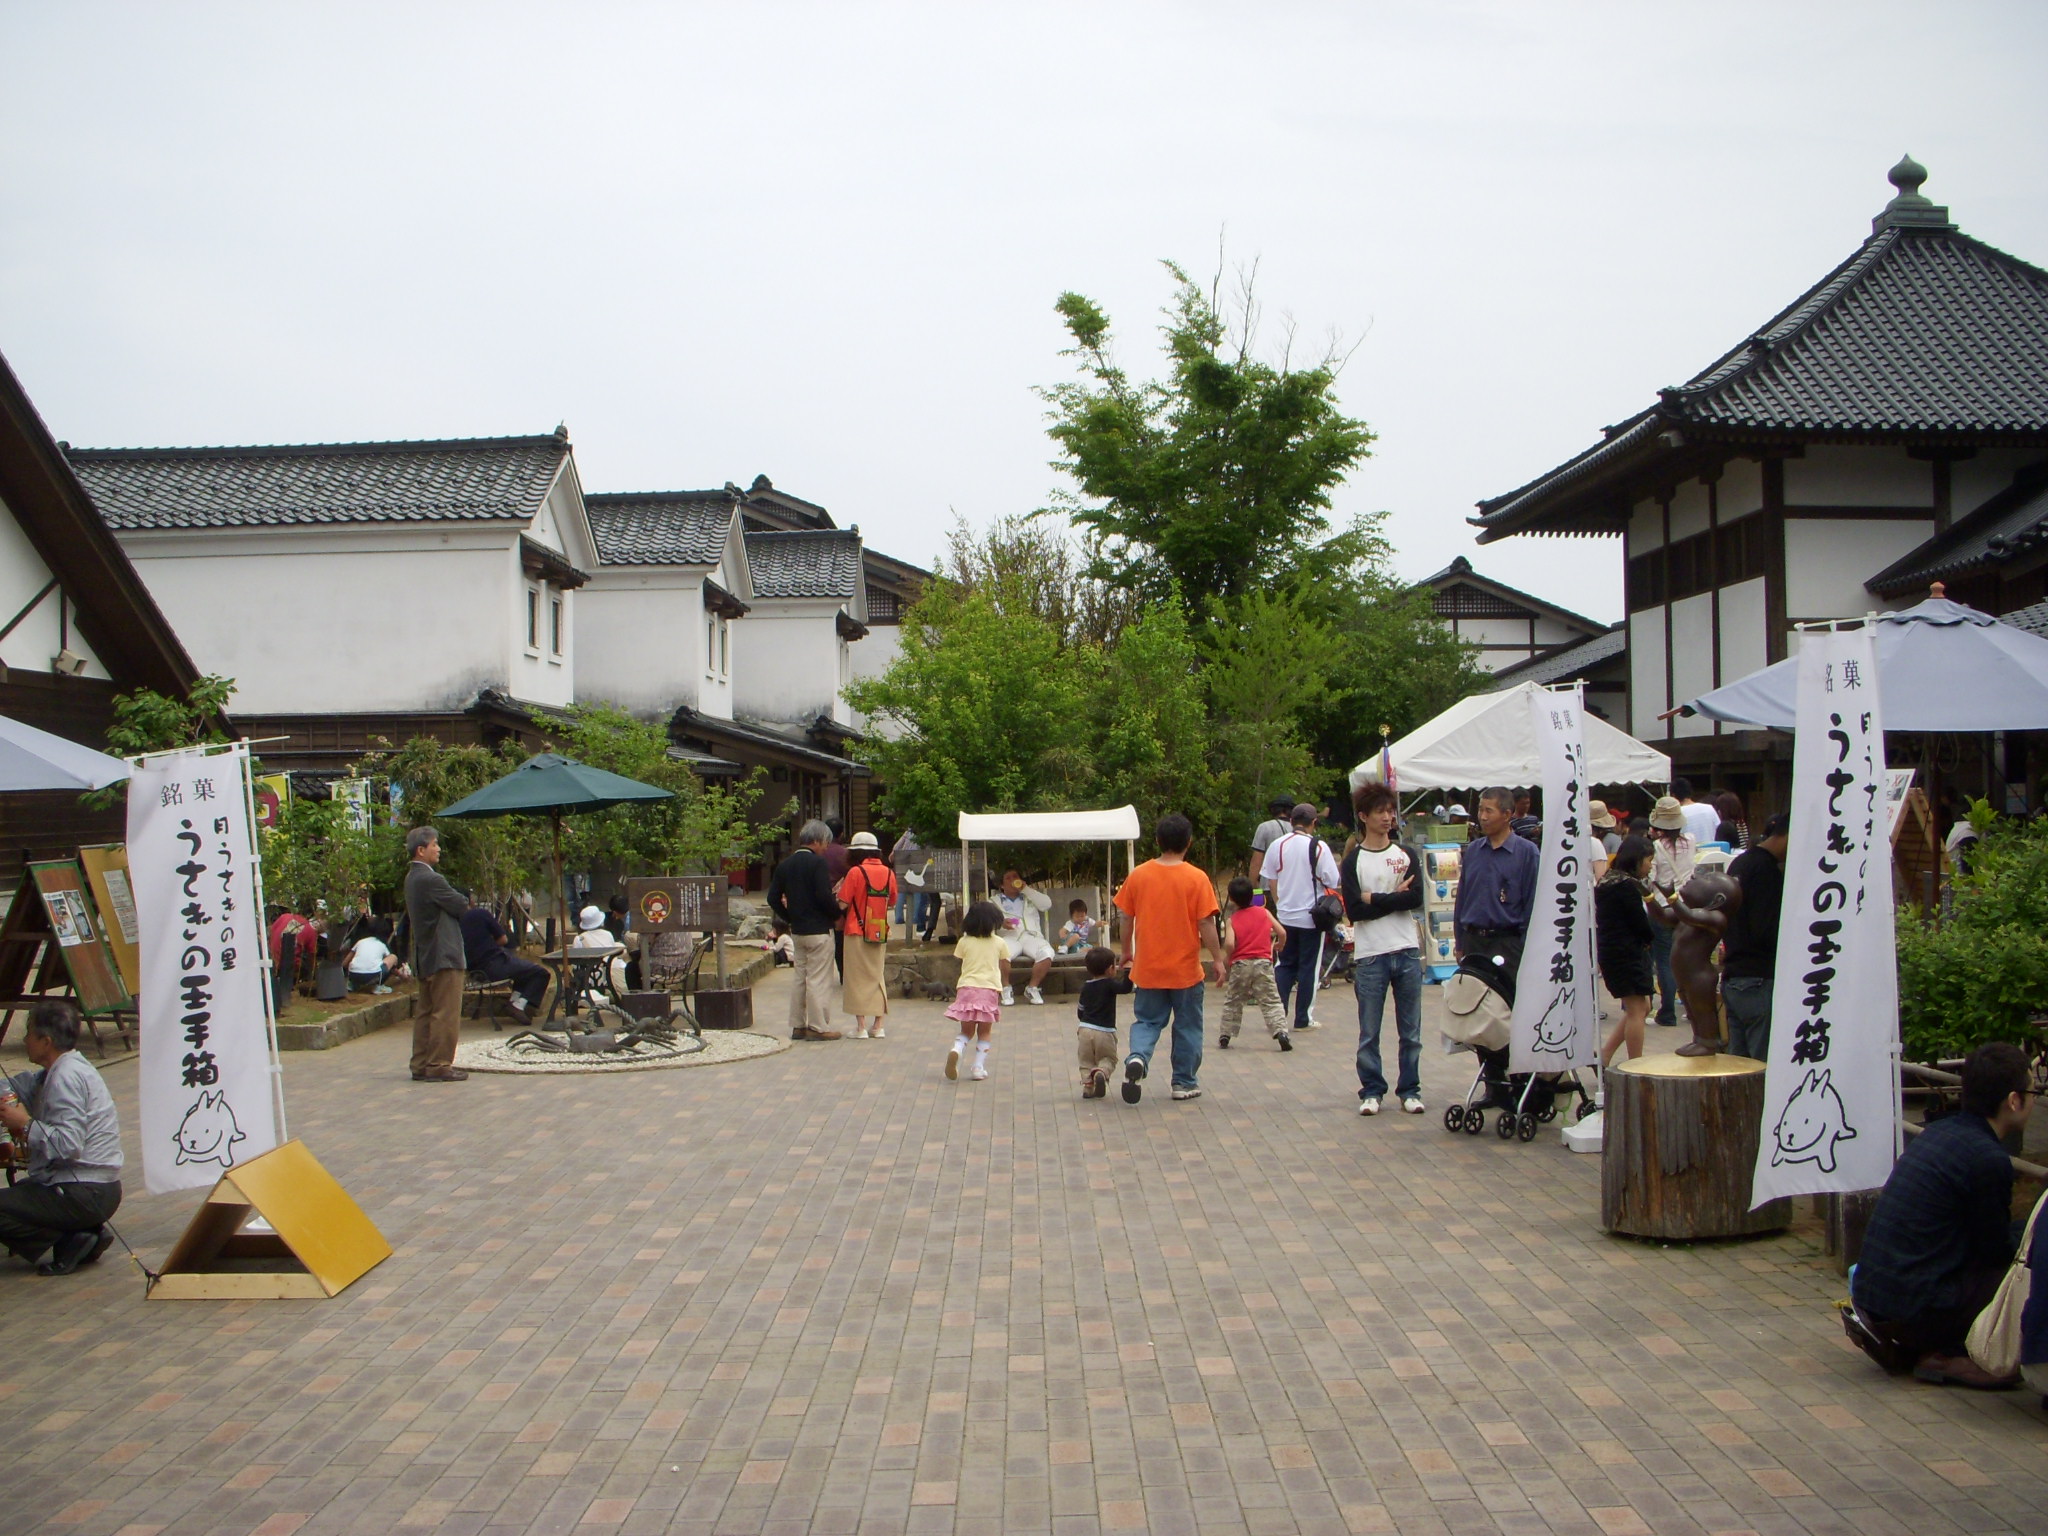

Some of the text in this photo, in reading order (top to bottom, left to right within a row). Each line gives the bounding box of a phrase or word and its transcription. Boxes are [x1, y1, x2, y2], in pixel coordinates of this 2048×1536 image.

[160, 778, 216, 807] 銘菓
[1550, 709, 1574, 731] 銘菓
[175, 818, 219, 1089] うさぎの玉手箱
[214, 816, 237, 971] 月うさぎの里
[1549, 742, 1581, 985] うさぎの玉手箱
[1790, 712, 1855, 1067] うさぎの玉手箱
